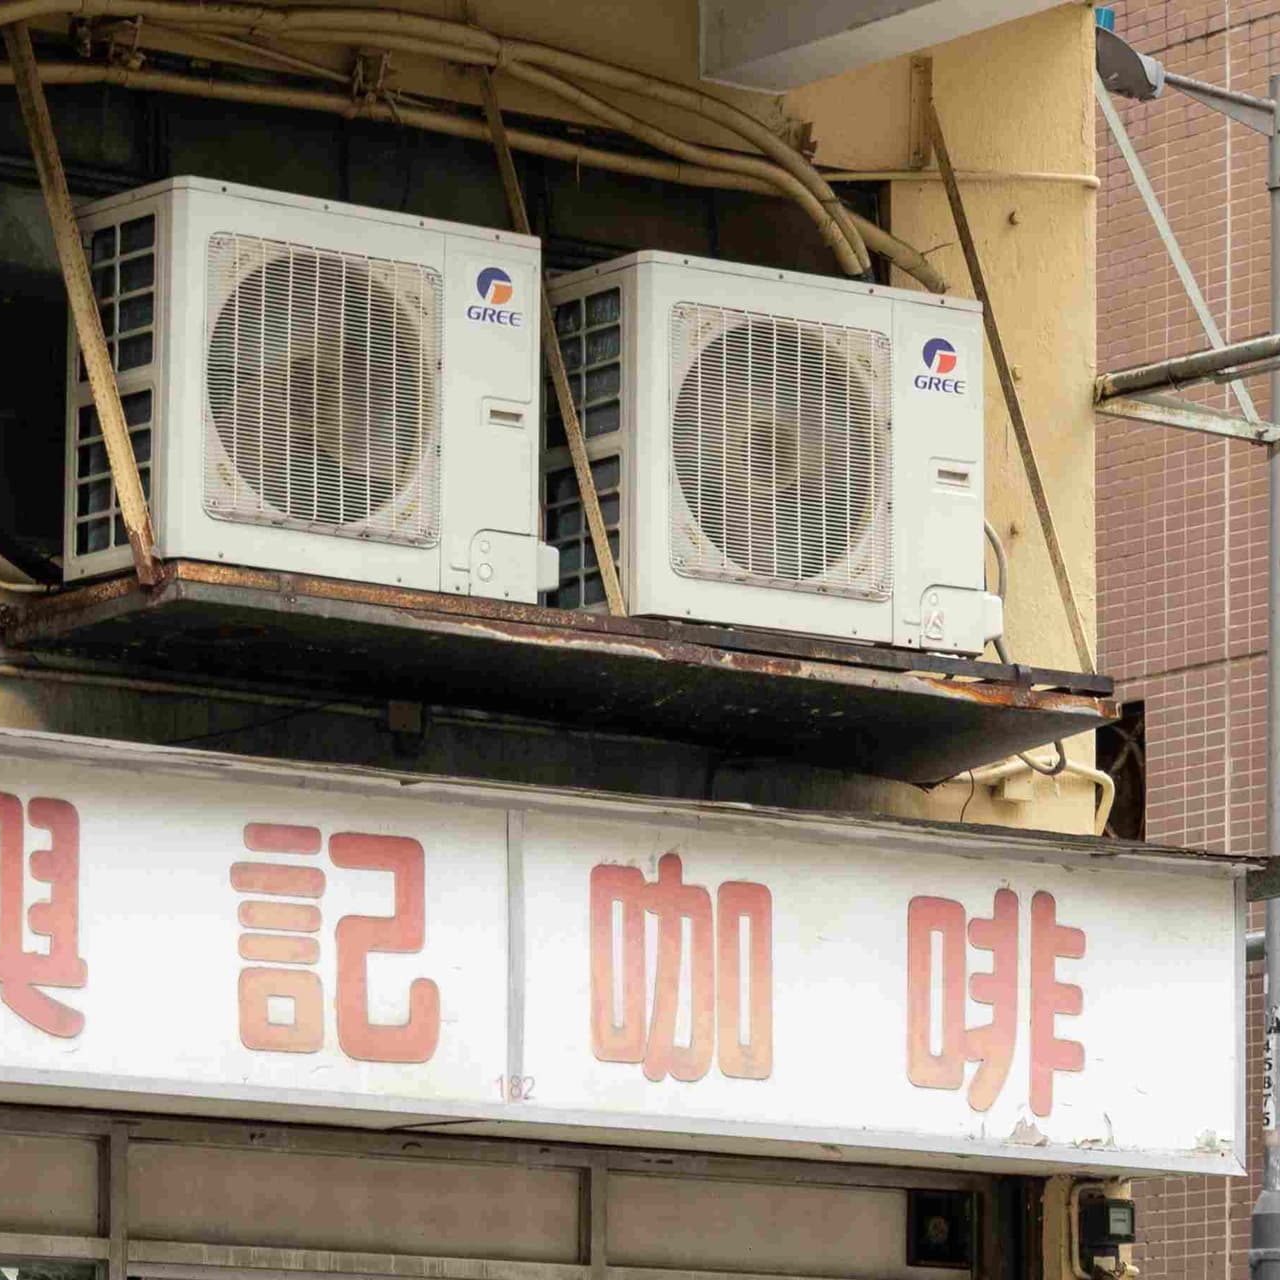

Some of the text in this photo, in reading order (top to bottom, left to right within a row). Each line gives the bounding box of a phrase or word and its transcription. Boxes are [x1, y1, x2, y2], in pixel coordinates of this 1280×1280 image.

[466, 304, 522, 328] GREE
[913, 374, 965, 396] GREE
[494, 1073, 535, 1100] 182
